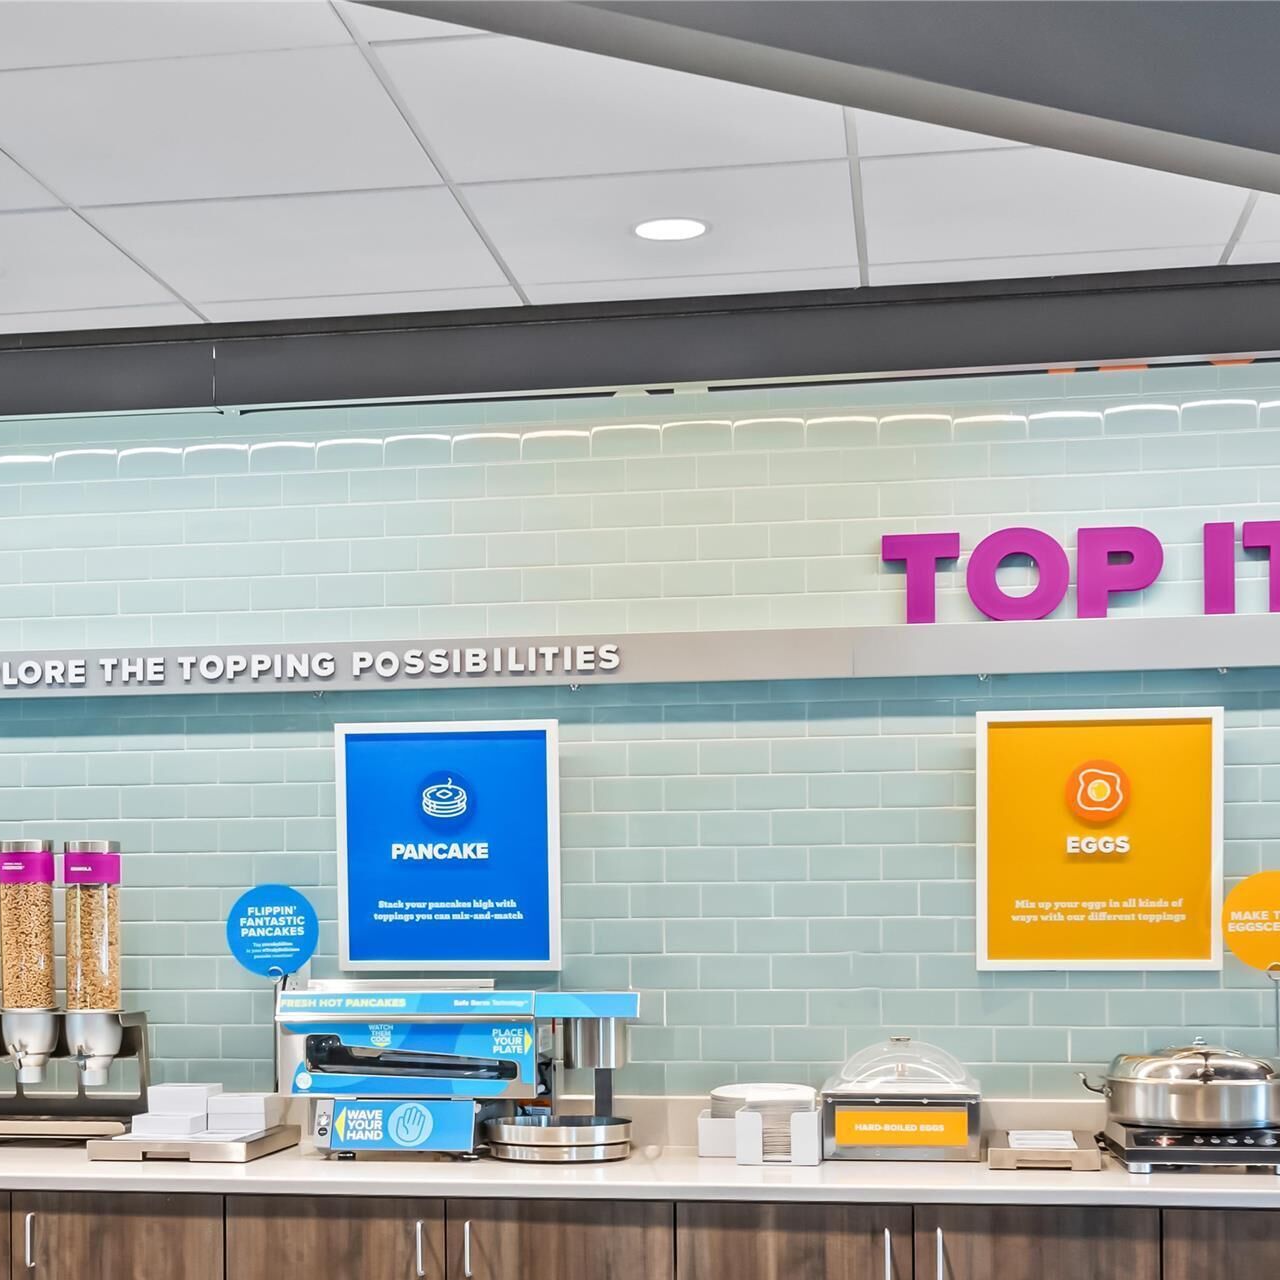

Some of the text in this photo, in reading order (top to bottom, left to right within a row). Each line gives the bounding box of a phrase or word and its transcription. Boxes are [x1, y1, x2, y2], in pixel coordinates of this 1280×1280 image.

[881, 525, 1164, 625] TOP
[99, 655, 165, 684] THE
[178, 651, 336, 682] TOPPING
[352, 643, 621, 678] POSSIBILITIES
[1066, 836, 1130, 853] EGGS
[391, 843, 489, 860] PANCAKE
[378, 899, 517, 912] Stack your pancakes high with
[1015, 898, 1184, 910] Mix up your eggs in all kinds of
[247, 905, 297, 916] FLIPPIN'
[1230, 911, 1269, 920] MAKE
[239, 916, 306, 927] FANTASTIC
[373, 912, 414, 923] toppings
[415, 914, 433, 922] you
[1011, 913, 1038, 923] ways
[1040, 911, 1065, 921] with
[1088, 911, 1136, 921] different
[1138, 911, 1186, 923] toppings
[241, 926, 305, 937] PANCAKES
[281, 998, 407, 1008] FRESH HOT PANCAKES
[492, 1028, 523, 1037] PLACE
[494, 1036, 523, 1046] YOUR
[492, 1045, 523, 1054] PLATE
[347, 1109, 383, 1119] WAVE
[347, 1119, 383, 1130] YOUR
[854, 1123, 917, 1131] HARD-BOILED
[346, 1129, 383, 1140] HAND
